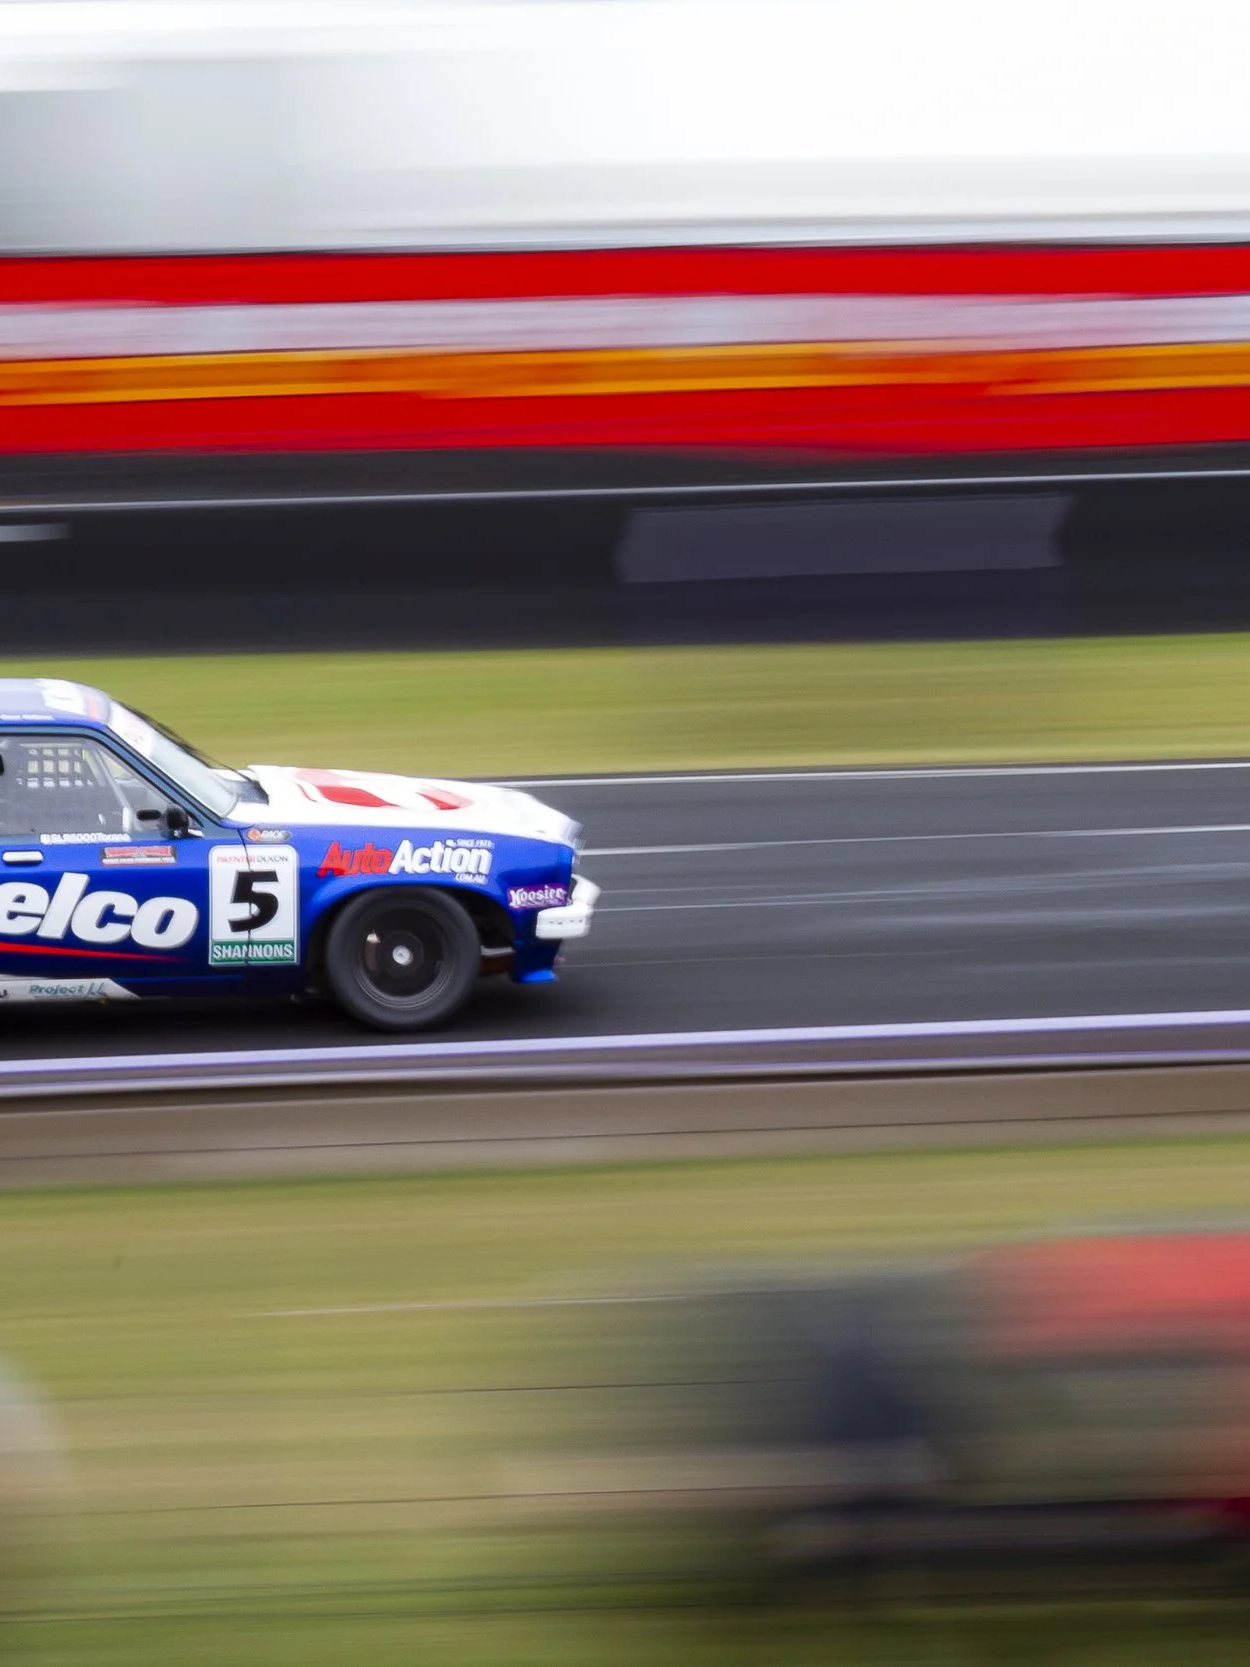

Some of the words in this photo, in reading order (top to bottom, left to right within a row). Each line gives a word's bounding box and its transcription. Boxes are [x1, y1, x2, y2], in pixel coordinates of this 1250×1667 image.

[256, 855, 288, 863] DIXON
[228, 870, 279, 933] 5
[509, 885, 567, 908] Hoosier
[213, 944, 294, 958] SHANNONS
[29, 984, 83, 995] Project
